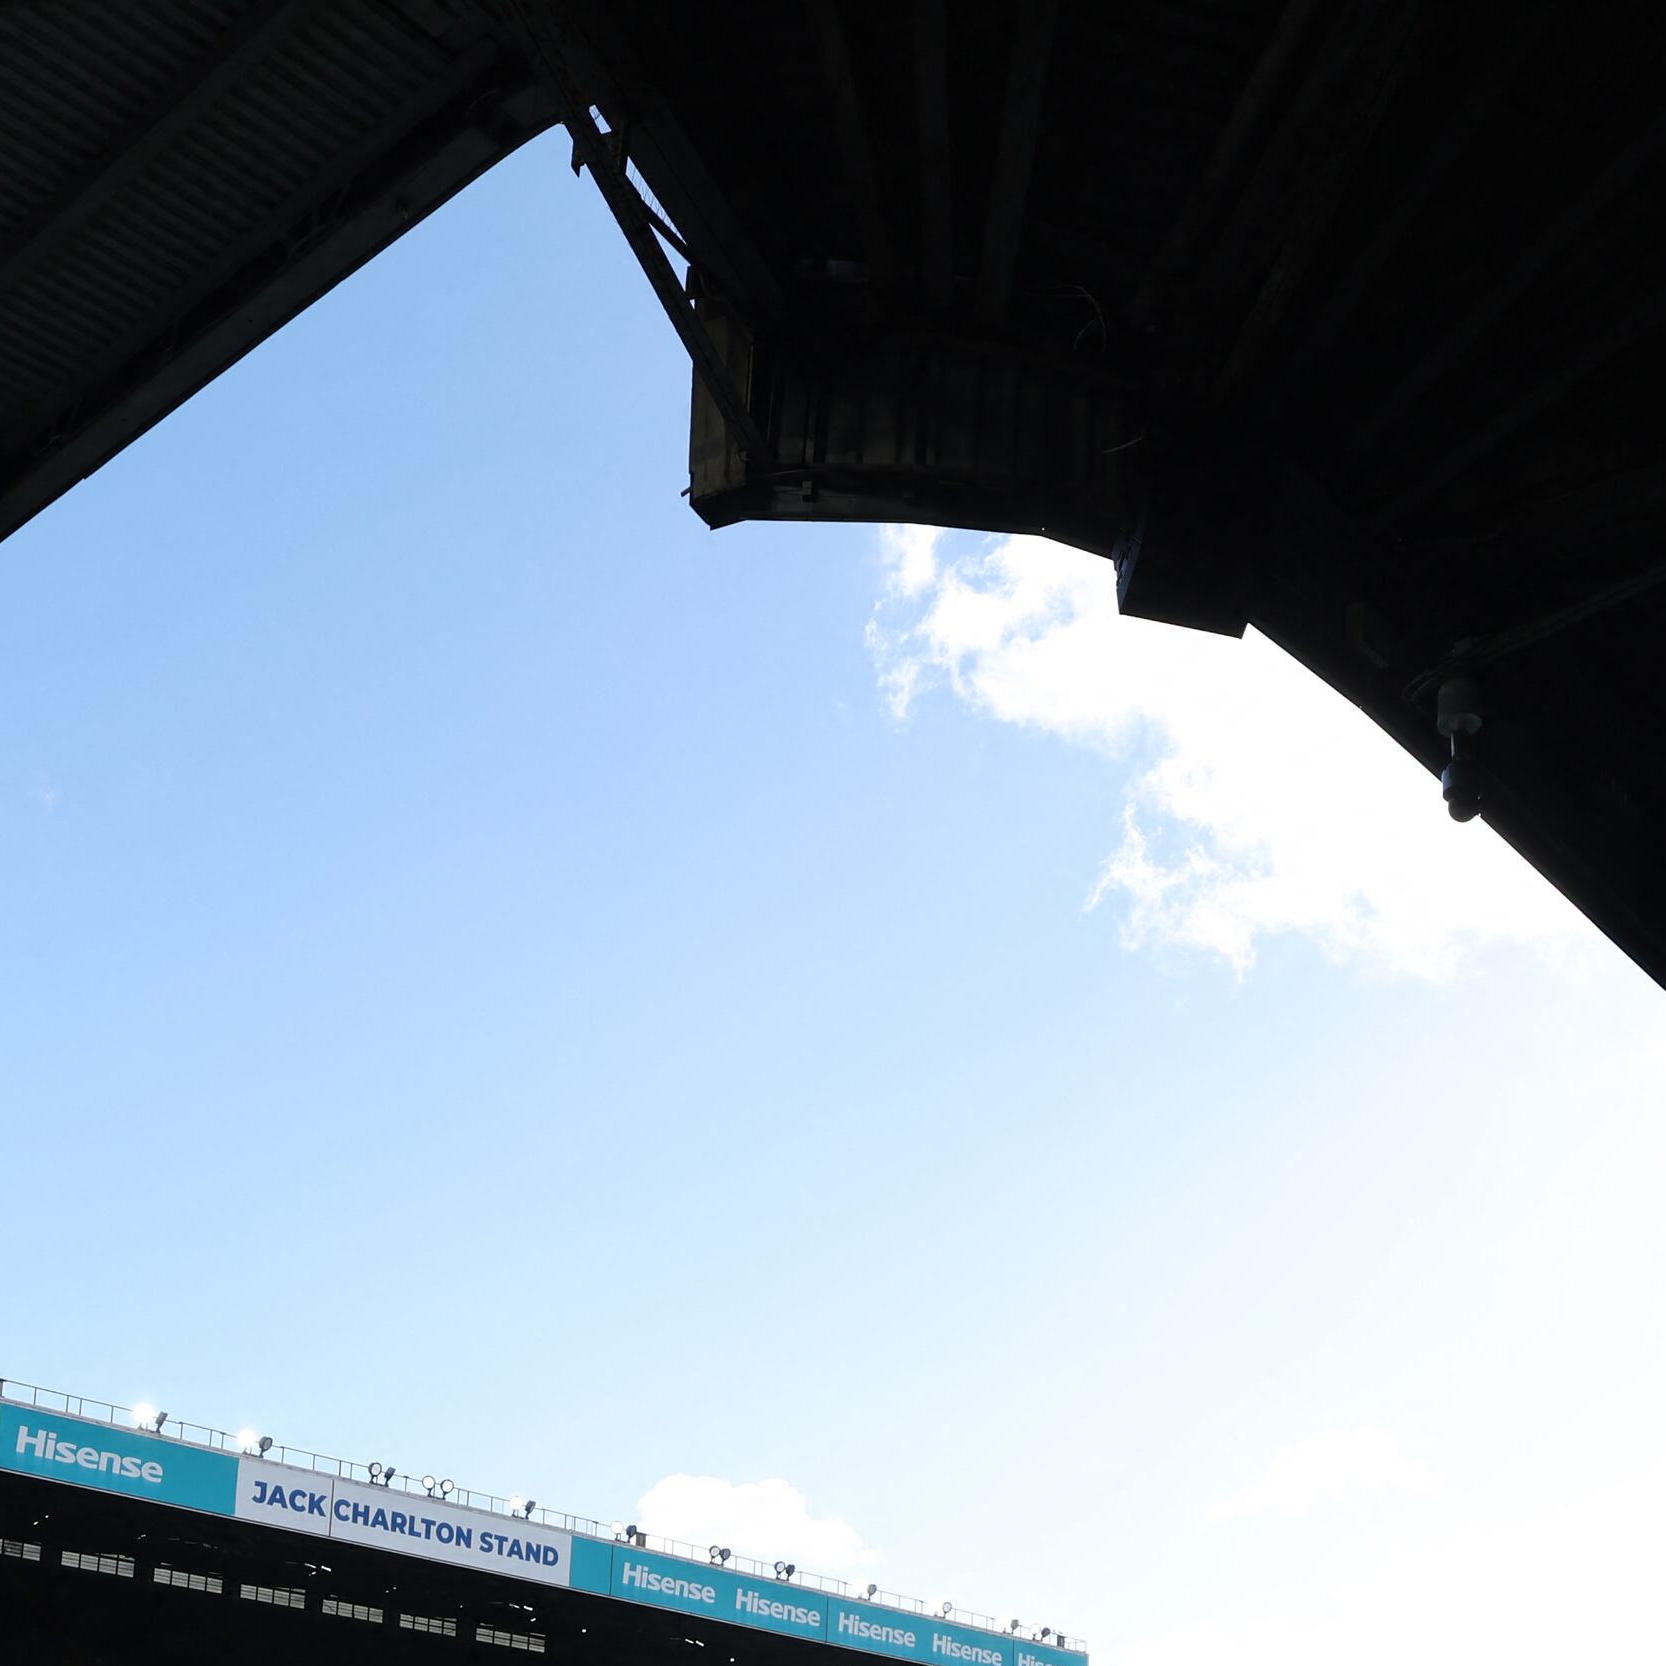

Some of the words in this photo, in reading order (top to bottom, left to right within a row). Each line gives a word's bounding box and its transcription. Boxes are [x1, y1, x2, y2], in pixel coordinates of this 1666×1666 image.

[15, 1425, 163, 1484] Hisense
[251, 1480, 327, 1518] JACK
[333, 1498, 473, 1549] CHARLTON
[479, 1530, 560, 1567] STAND
[622, 1562, 716, 1604] Hisense
[735, 1588, 821, 1628] Hisense
[838, 1612, 916, 1648] Hisense
